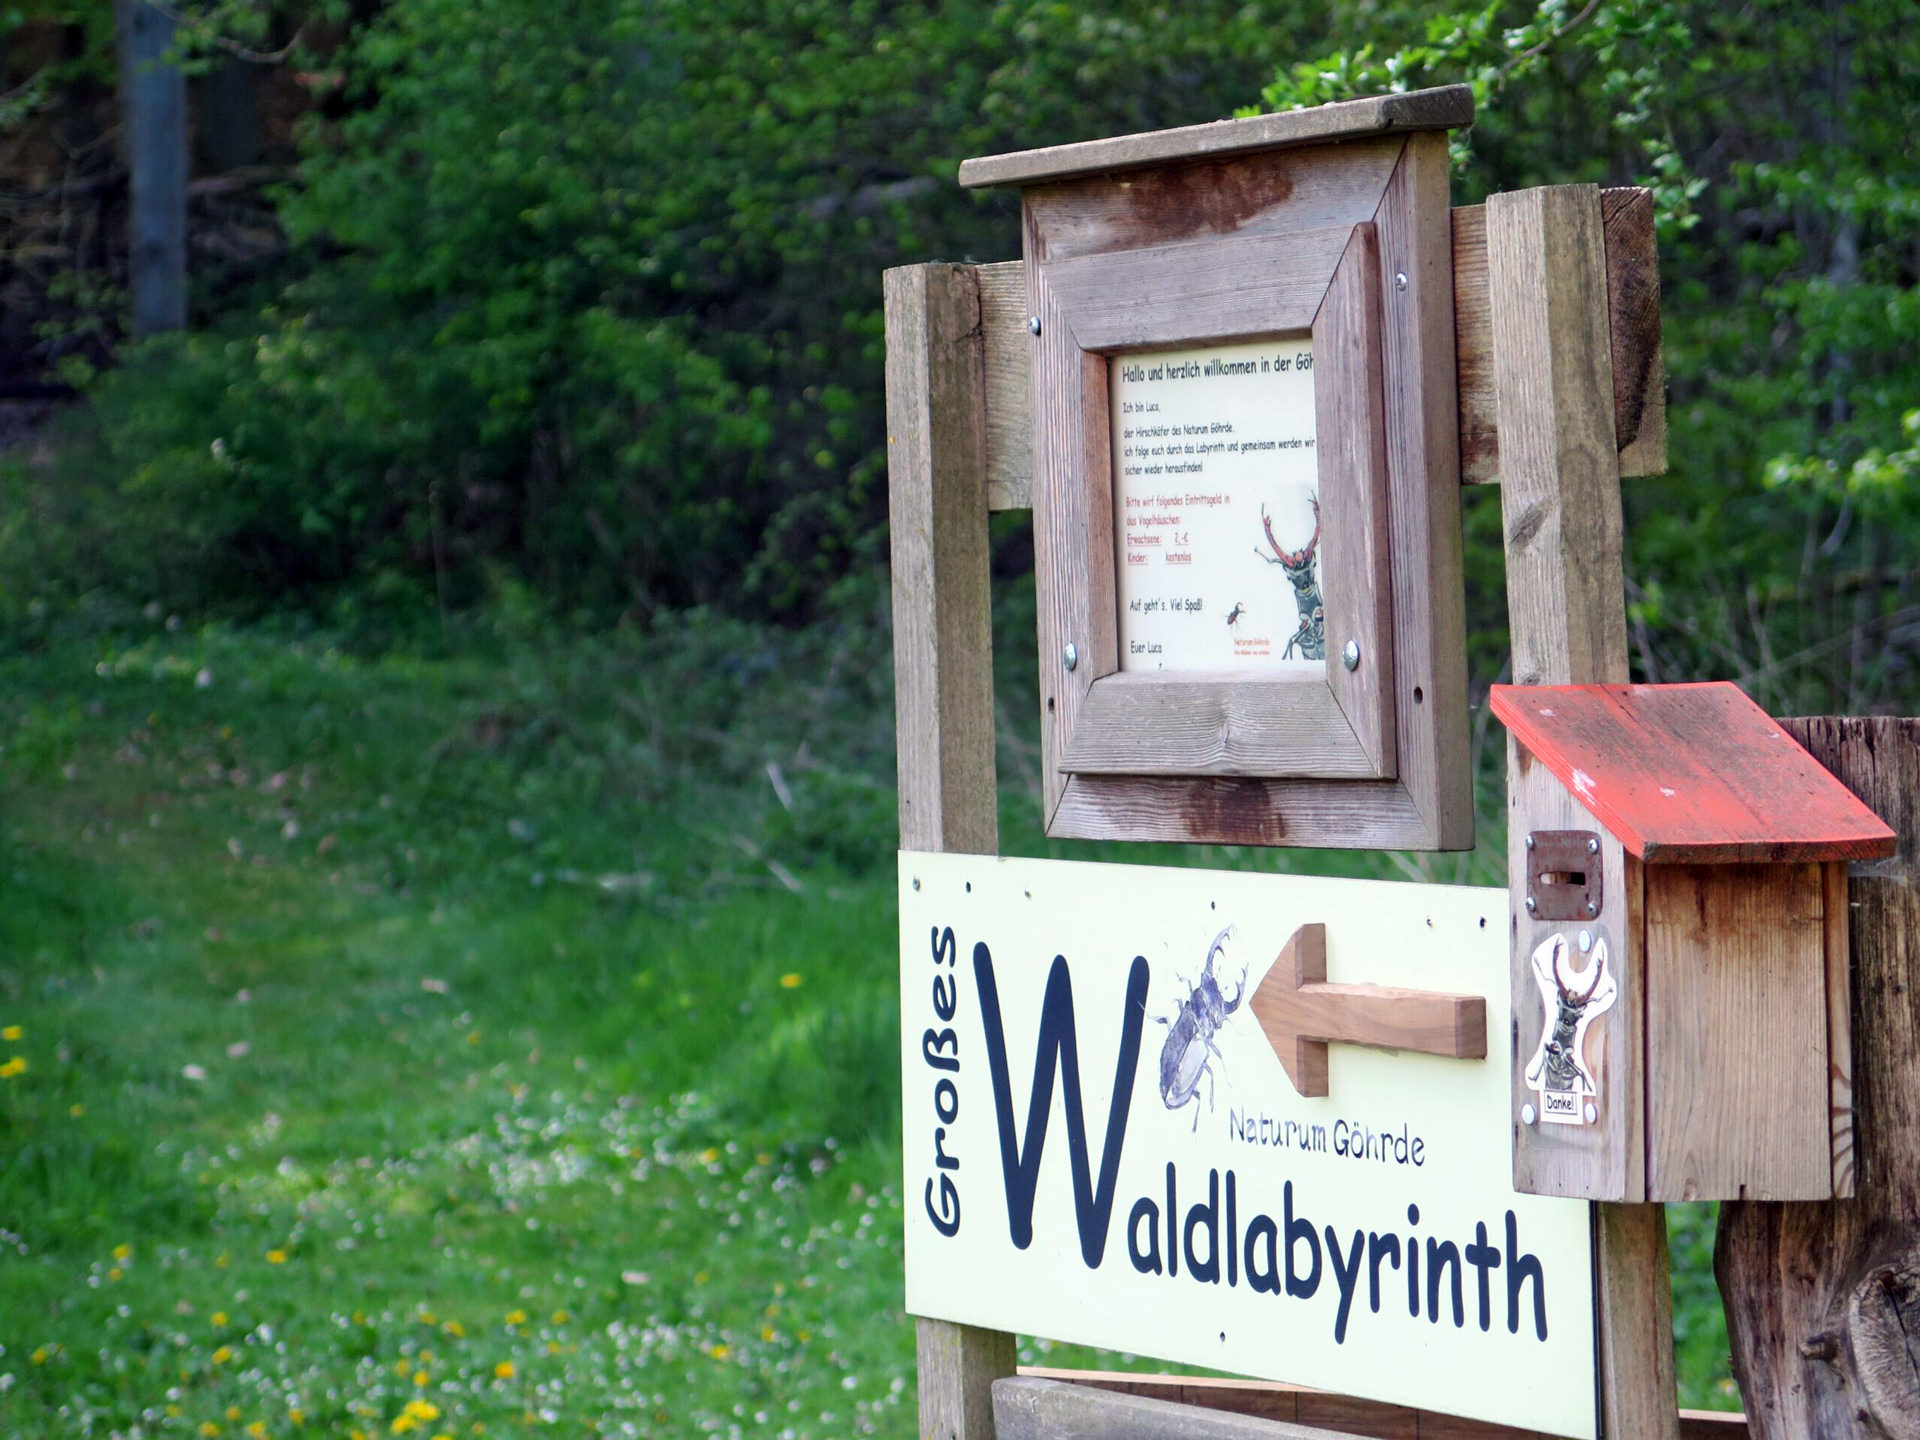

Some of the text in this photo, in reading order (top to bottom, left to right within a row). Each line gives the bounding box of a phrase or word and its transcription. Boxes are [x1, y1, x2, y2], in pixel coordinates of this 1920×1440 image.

[1122, 364, 1145, 382] Hallo
[1148, 363, 1163, 381] und
[1166, 360, 1200, 379] herzlich
[1203, 358, 1257, 376] willkommen
[1260, 356, 1270, 372] in
[1274, 354, 1291, 372] der
[1123, 402, 1133, 413] Ich
[1135, 401, 1144, 413] bin
[1123, 427, 1134, 439] der
[1135, 425, 1170, 438] Hirschkäfer
[1171, 424, 1182, 436] des
[1183, 424, 1209, 436] Naturum
[1124, 436, 1316, 459] ich folge euch durch das Labyrinth und gemeinsam werden wir
[1125, 464, 1143, 476] sicher
[1144, 463, 1163, 474] wieder
[1126, 495, 1141, 508] Bitte
[1156, 494, 1183, 510] folgendes
[1185, 492, 1222, 508] Eintrittsgeld
[1129, 598, 1142, 611] Auf
[1170, 598, 1183, 611] Viel
[1130, 640, 1162, 654] Euer Luca
[925, 925, 960, 1238] Großes
[1546, 1094, 1574, 1110] Danke!
[973, 941, 1548, 1345] Waldlabyrinth
[1229, 1107, 1426, 1167] Naturum Göhrde
